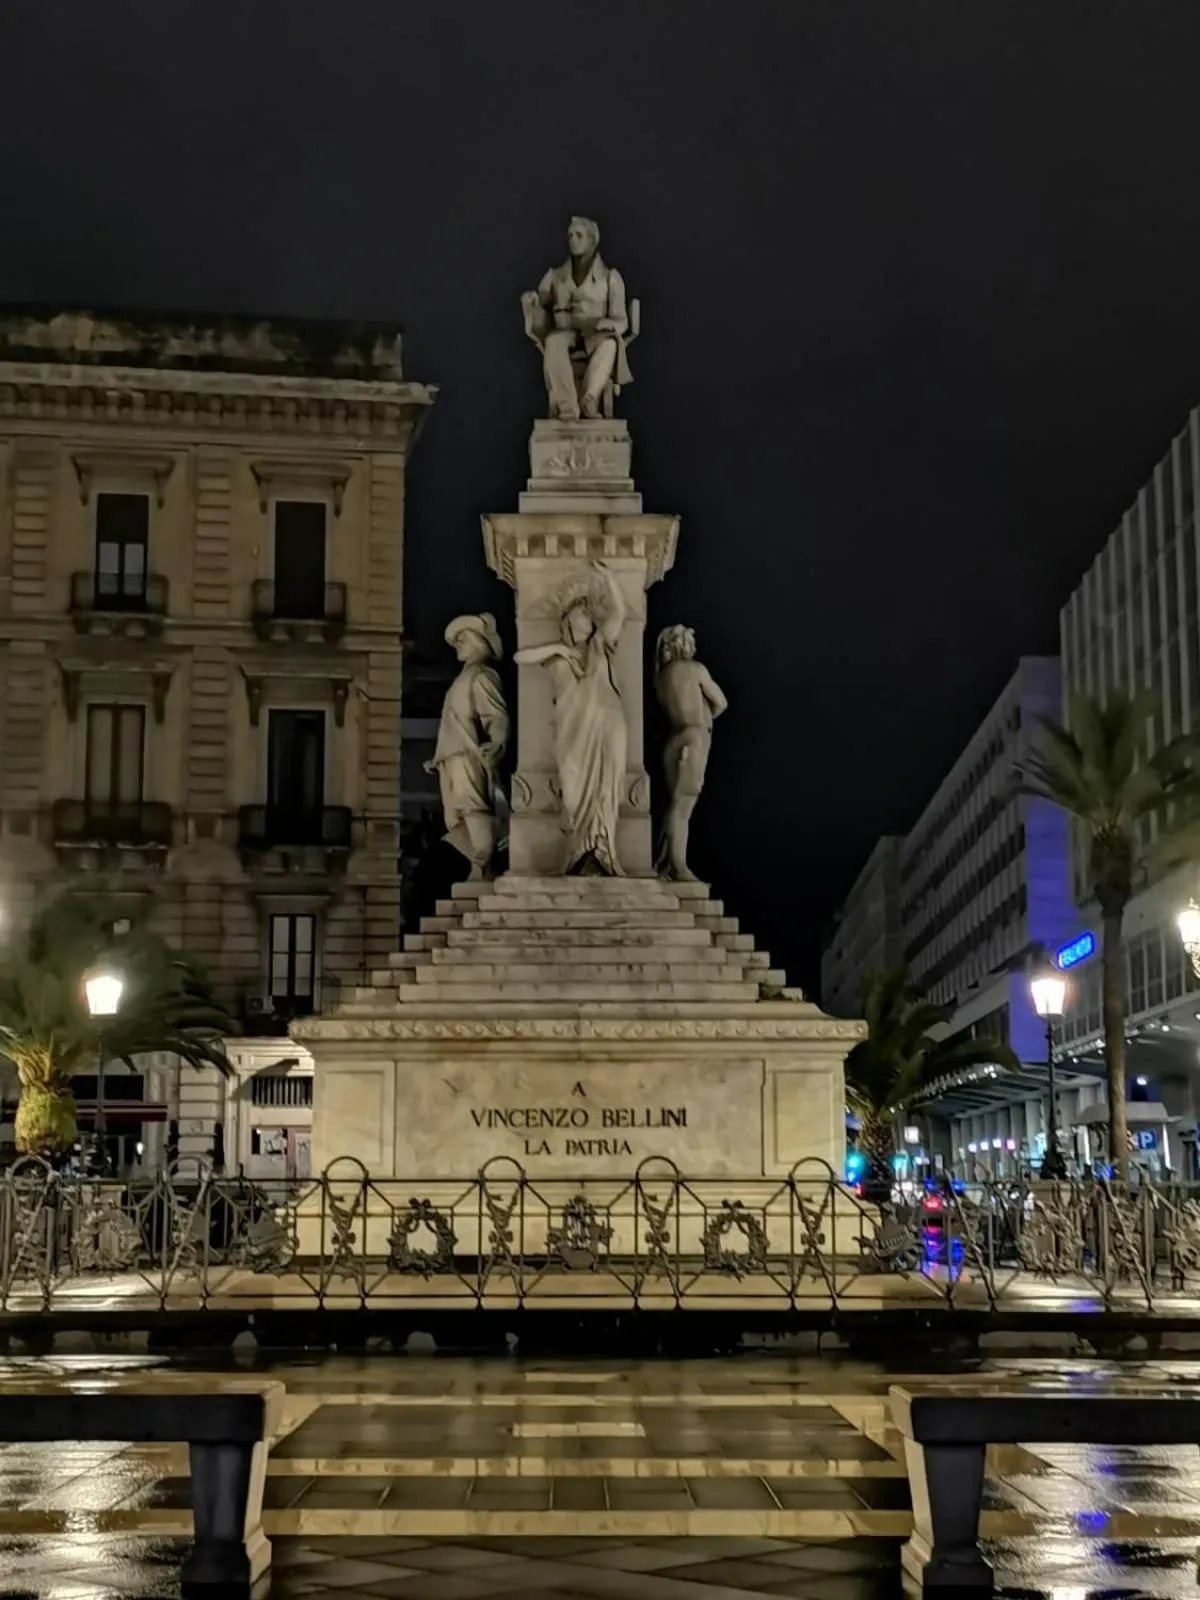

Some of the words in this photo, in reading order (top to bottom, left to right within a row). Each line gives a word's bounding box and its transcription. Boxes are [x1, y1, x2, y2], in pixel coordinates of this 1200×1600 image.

[572, 1081, 586, 1097] A
[470, 1107, 589, 1128] VINCENZO
[602, 1107, 687, 1128] BELLINI
[524, 1139, 551, 1156] LA
[565, 1139, 632, 1156] PATRIA
[1140, 1131, 1153, 1148] P
